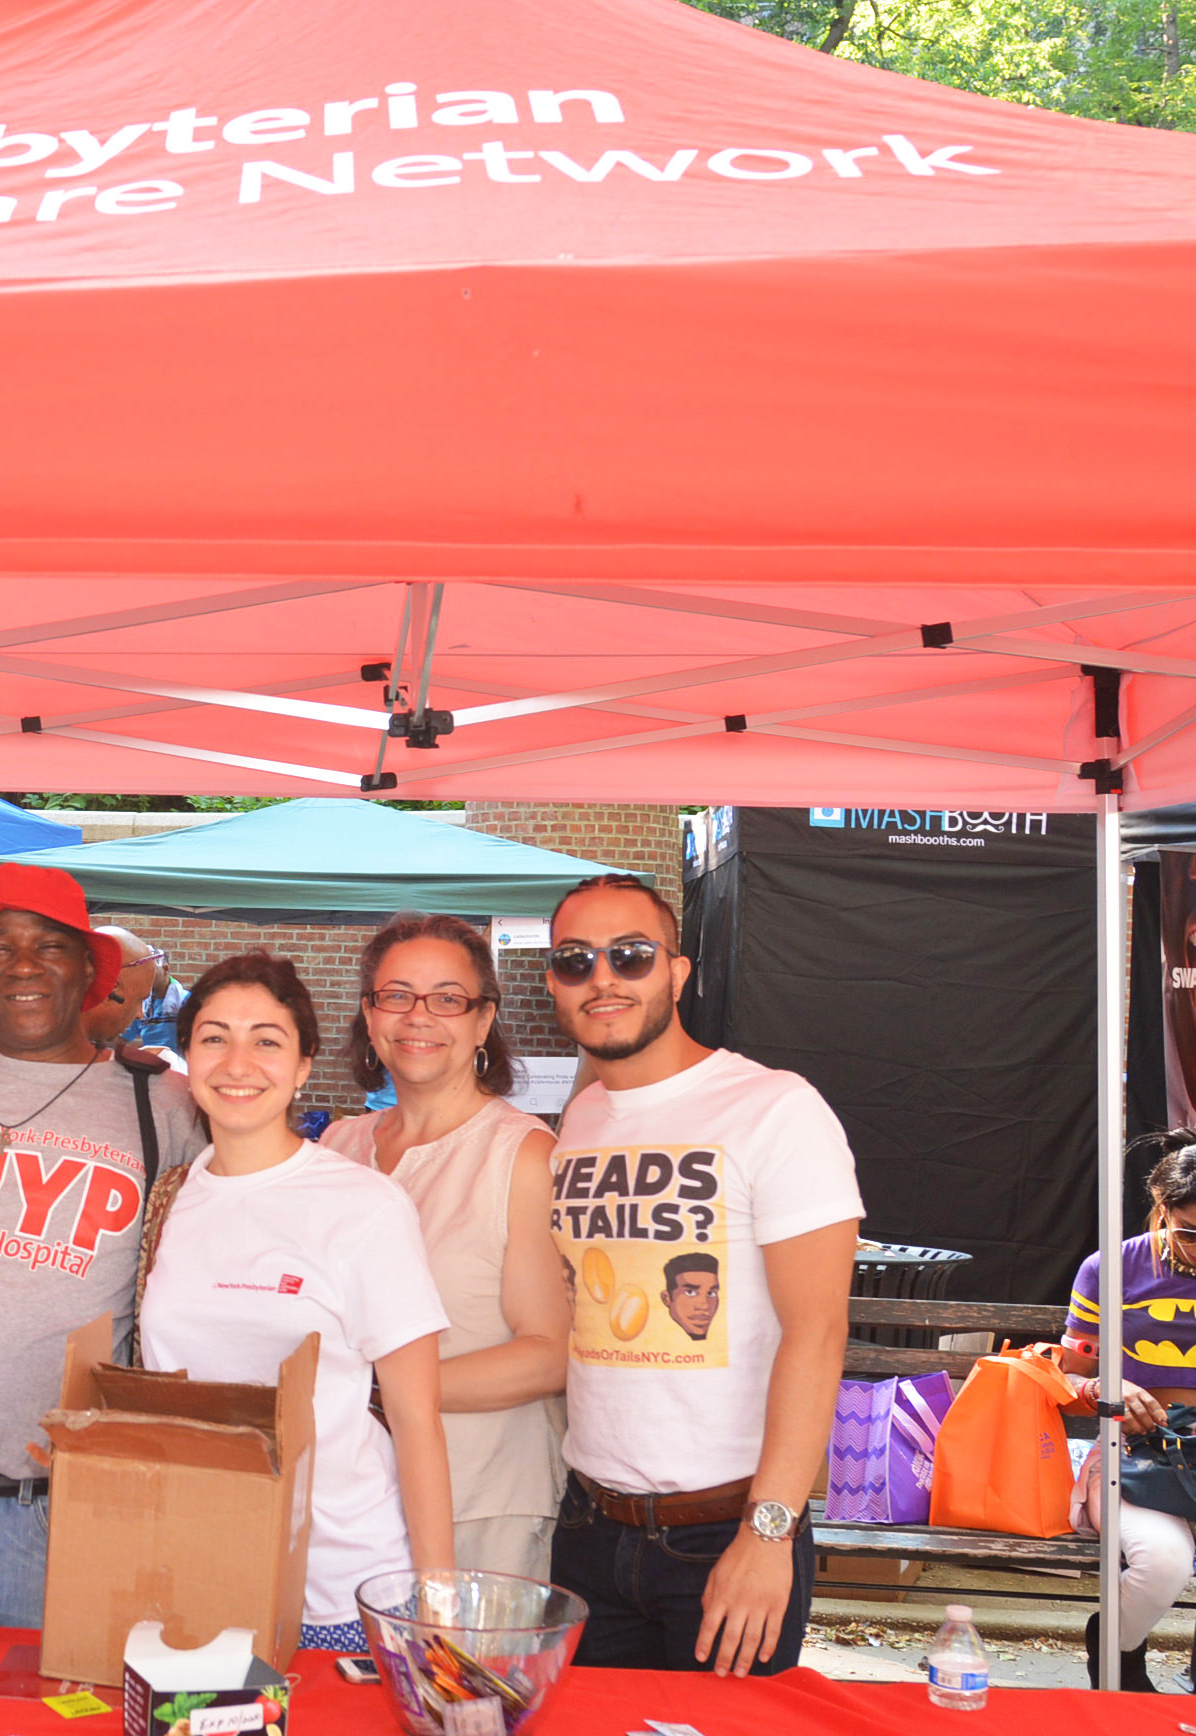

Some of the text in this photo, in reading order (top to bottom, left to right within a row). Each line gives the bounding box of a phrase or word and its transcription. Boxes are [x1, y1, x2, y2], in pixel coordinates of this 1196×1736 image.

[237, 134, 1003, 205] Network
[887, 833, 986, 848] mashbooths.com
[565, 1202, 715, 1243] TAILS?
